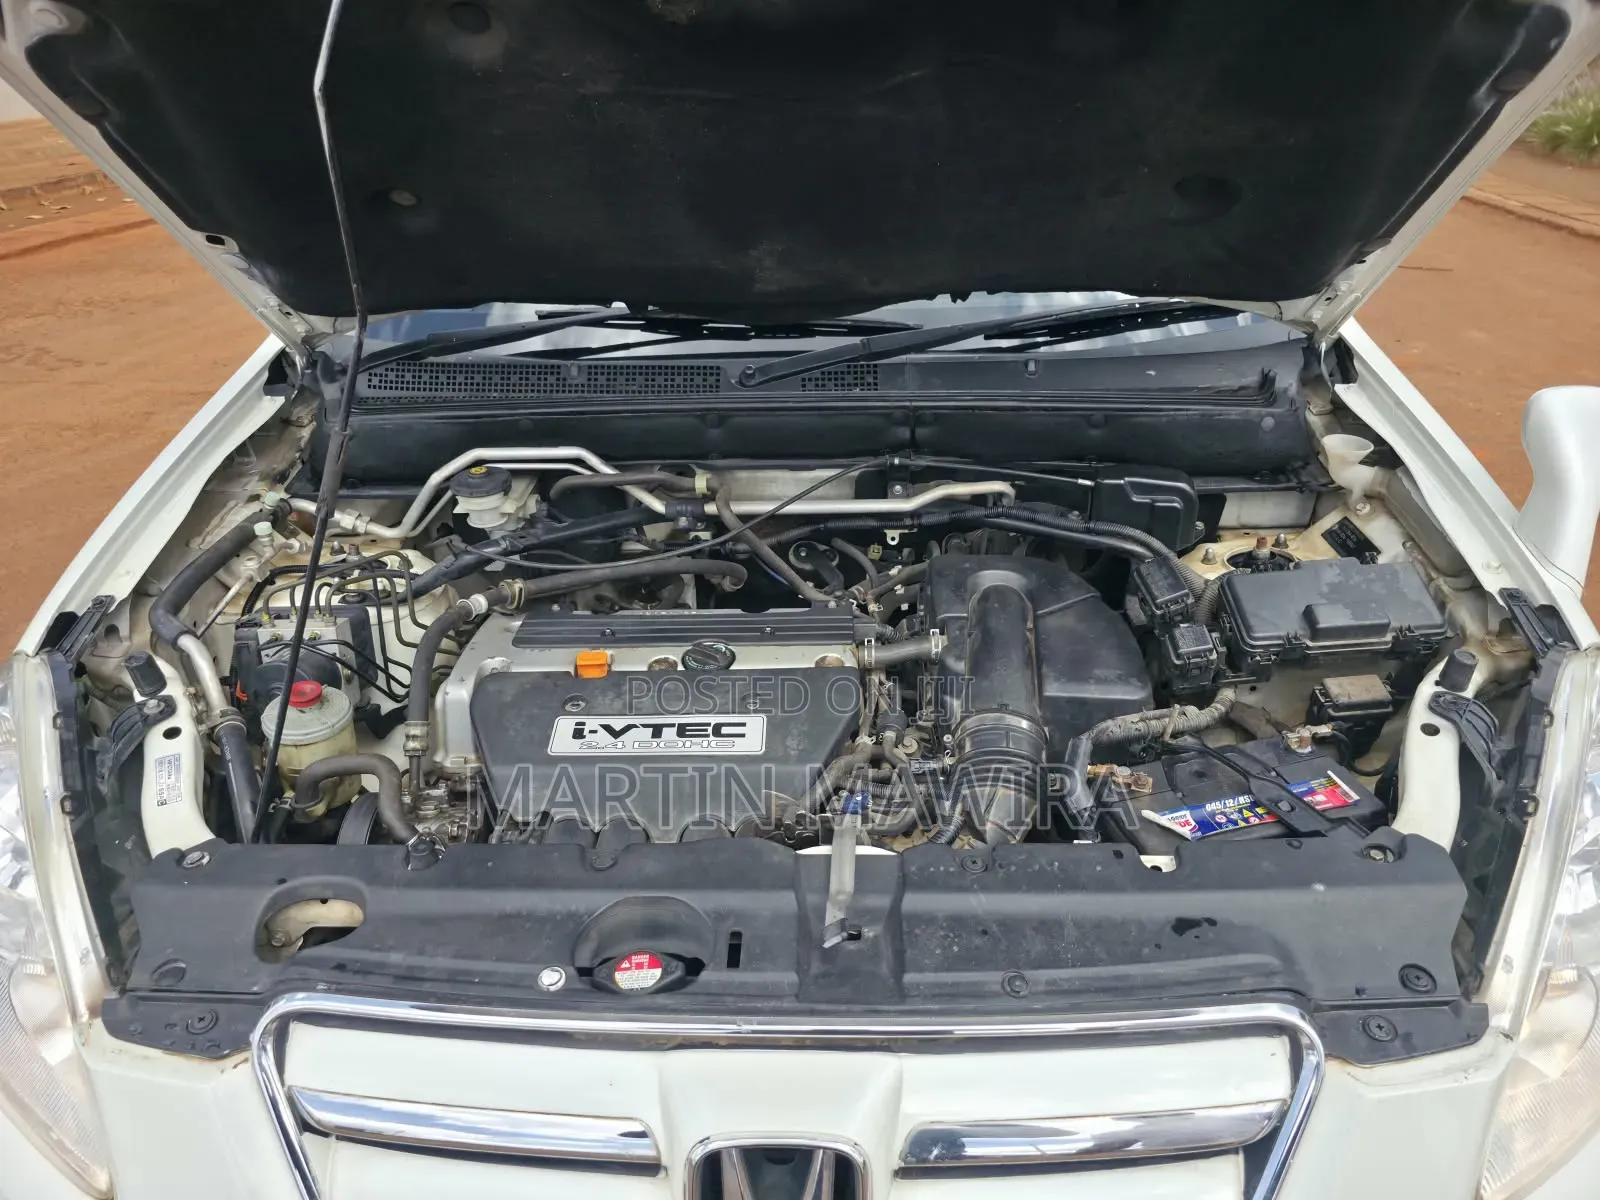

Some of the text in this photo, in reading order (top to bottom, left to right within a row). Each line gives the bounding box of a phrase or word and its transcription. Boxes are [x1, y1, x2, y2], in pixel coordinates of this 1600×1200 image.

[572, 721, 747, 740] i-VTEC
[579, 740, 736, 750] 2.4 DOHC
